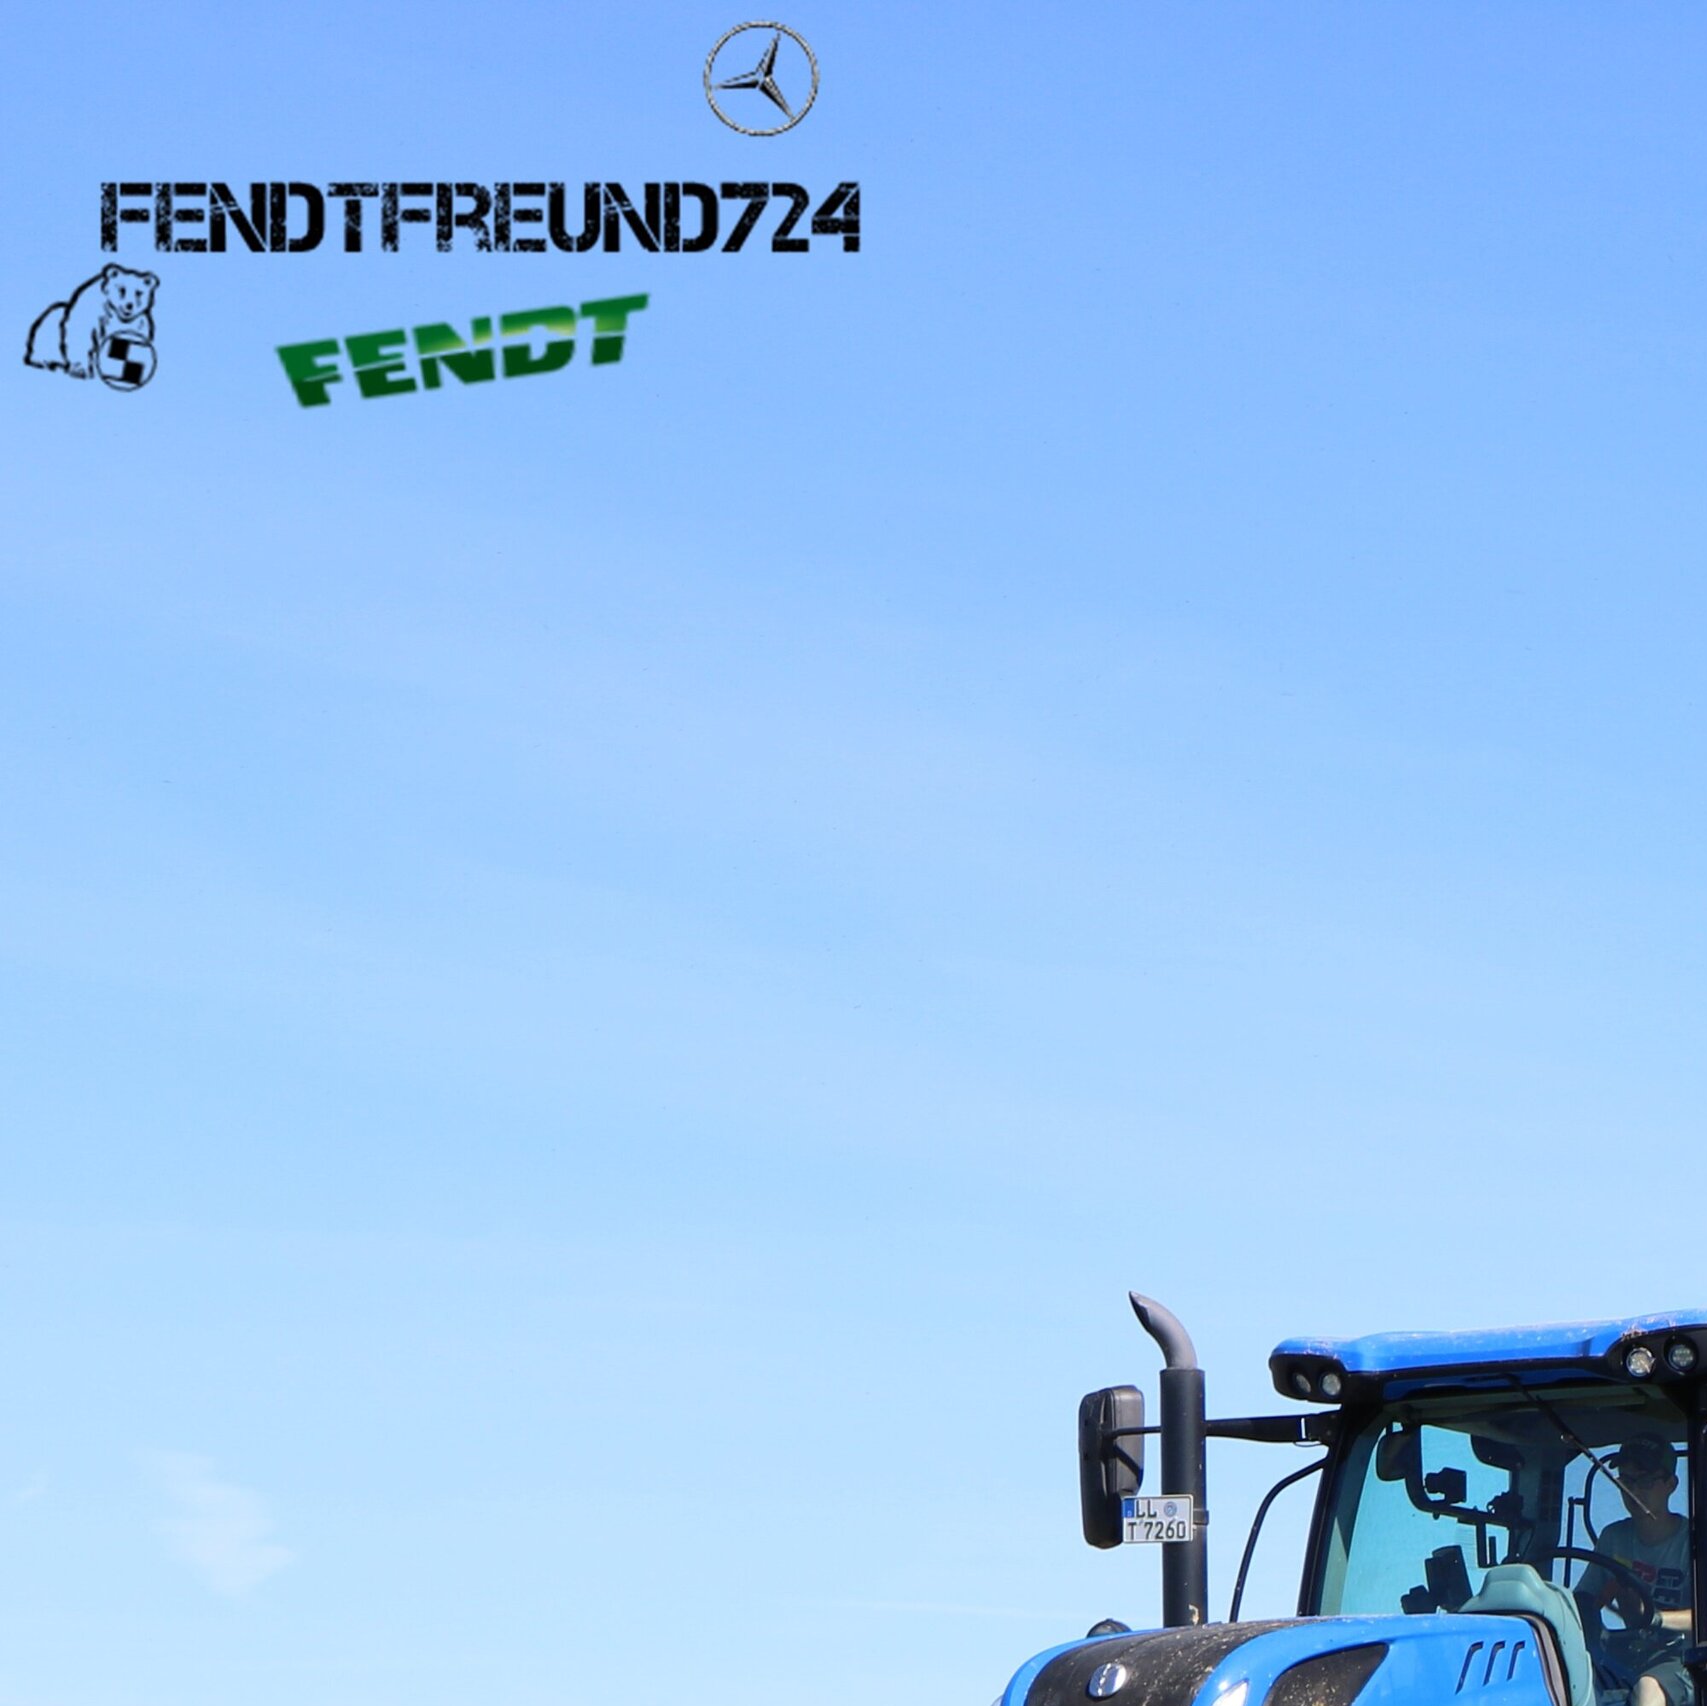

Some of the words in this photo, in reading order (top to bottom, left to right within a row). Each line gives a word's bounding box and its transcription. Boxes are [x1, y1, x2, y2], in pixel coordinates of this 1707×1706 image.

[1136, 1500, 1157, 1518] LL
[1128, 1522, 1136, 1540] T
[1144, 1521, 1186, 1539] 7260
